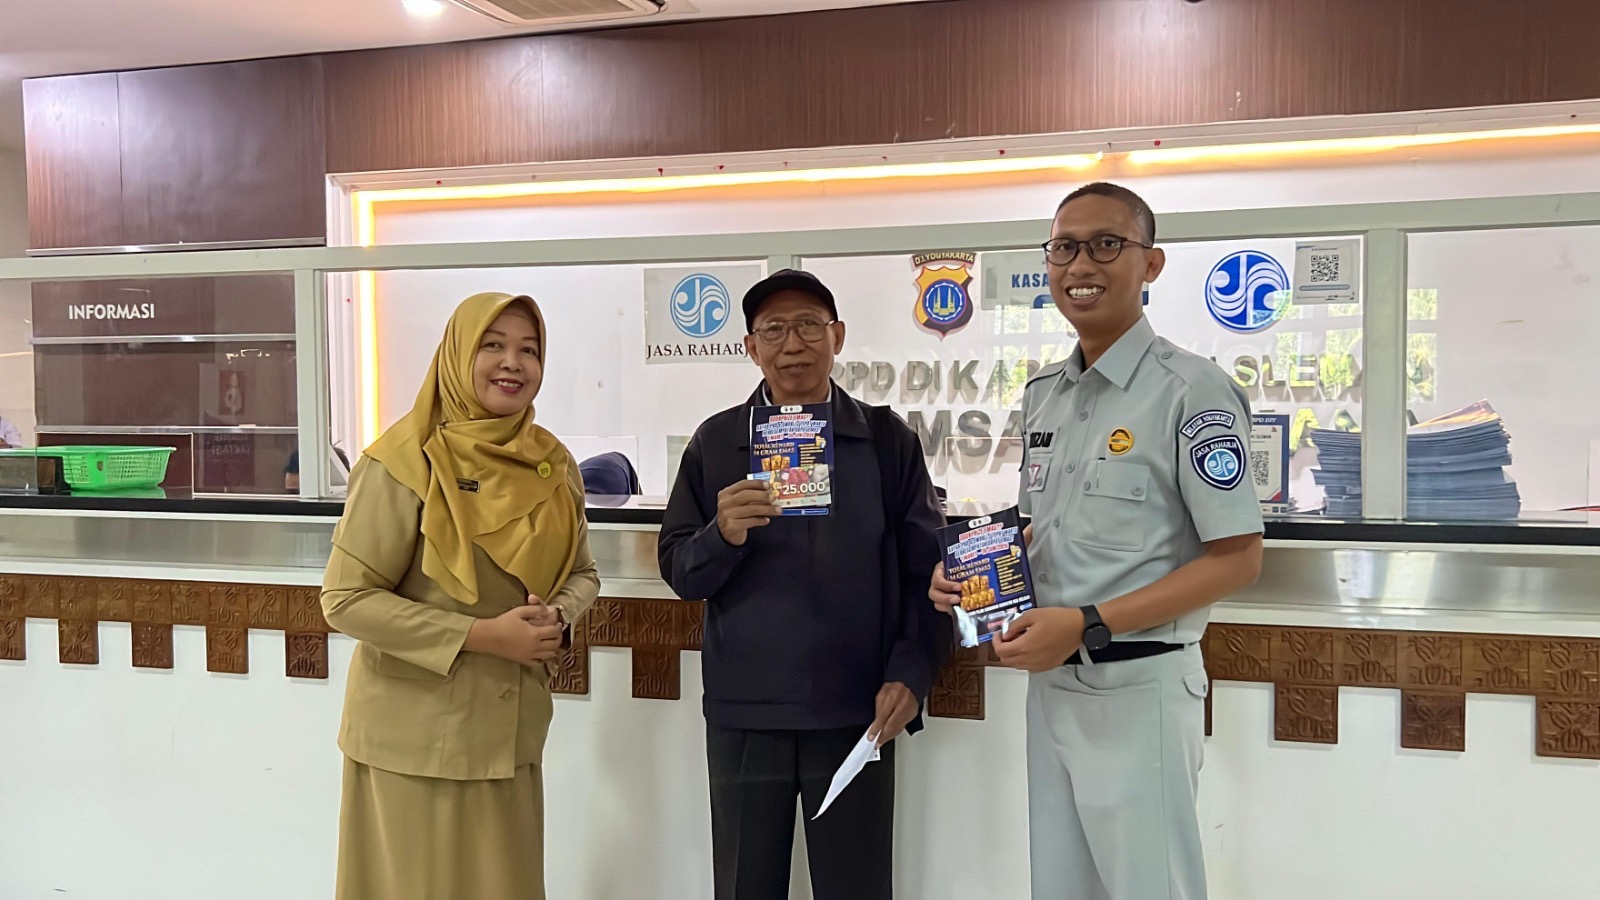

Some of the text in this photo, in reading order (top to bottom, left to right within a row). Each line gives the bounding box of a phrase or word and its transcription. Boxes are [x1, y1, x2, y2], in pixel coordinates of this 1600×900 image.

[68, 303, 155, 320] INFORMASI
[646, 344, 683, 359] JASA
[906, 360, 941, 391] DI
[1195, 441, 1238, 458] JASA RAHARJA
[782, 481, 826, 495] 25.000
